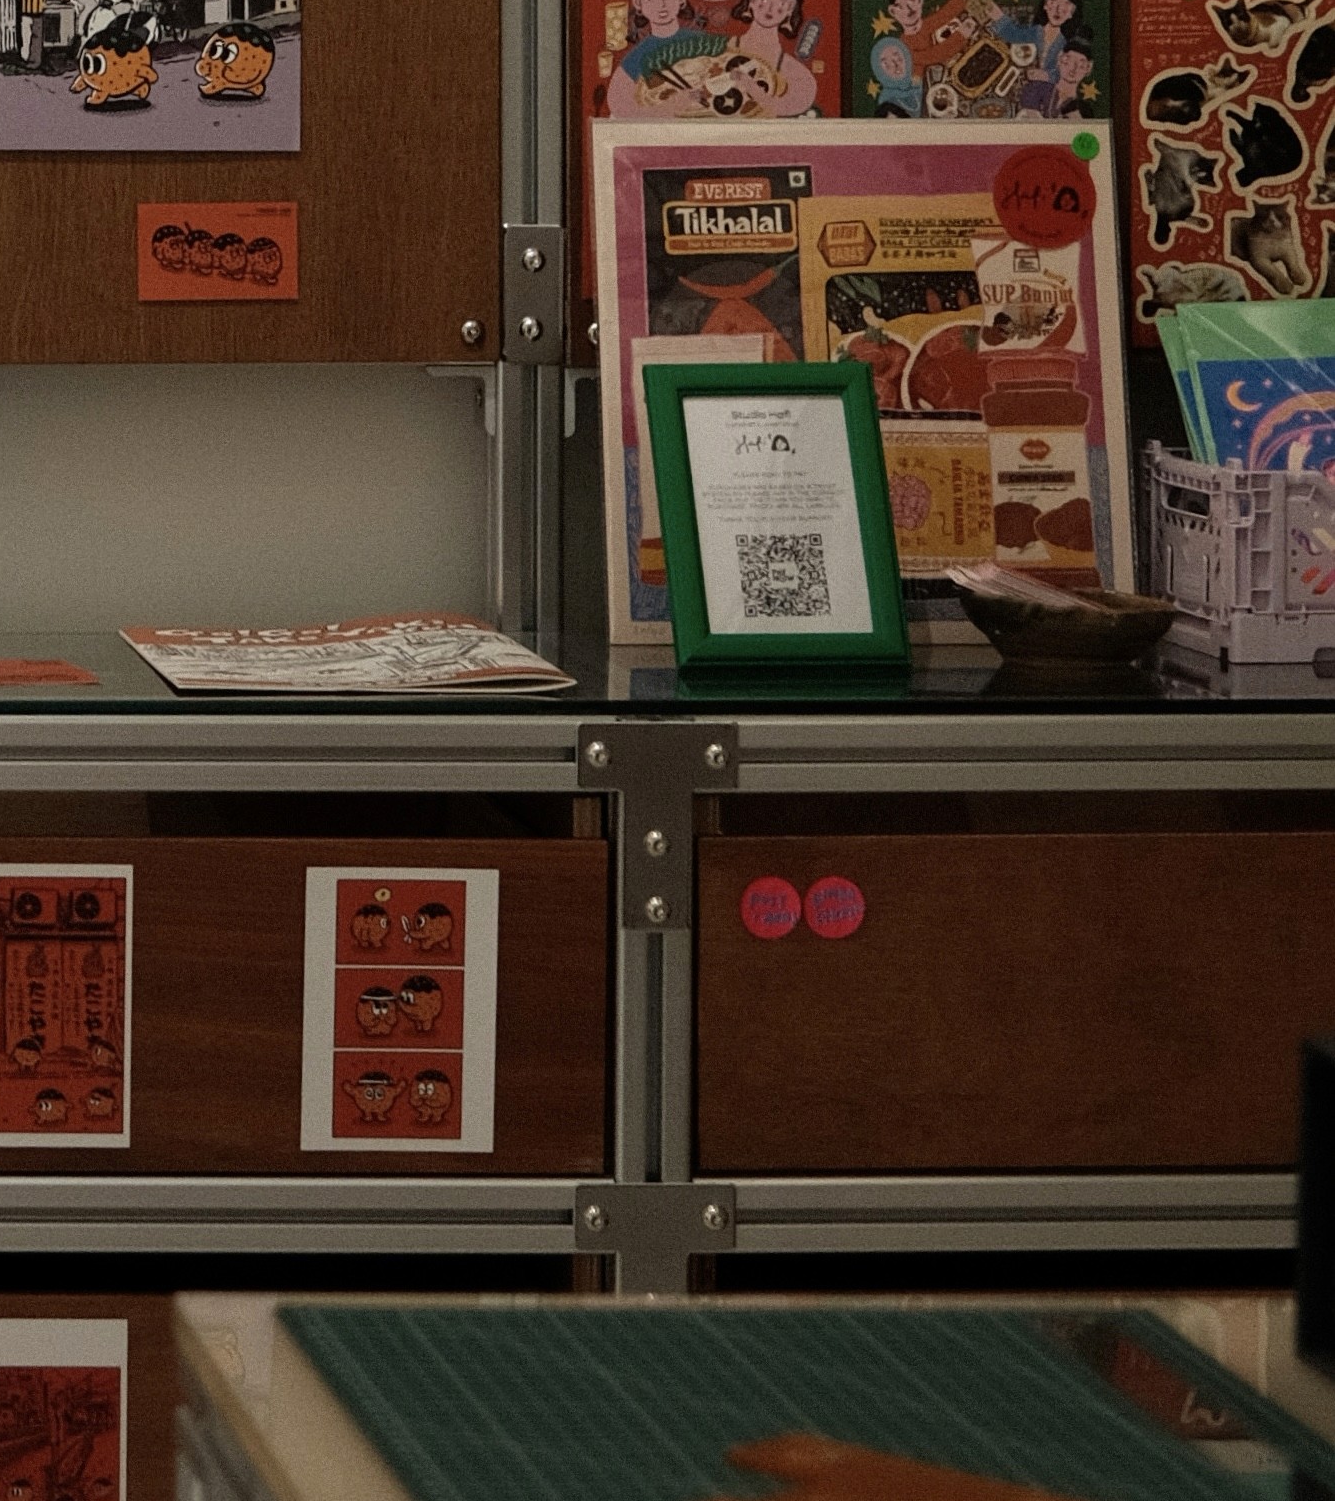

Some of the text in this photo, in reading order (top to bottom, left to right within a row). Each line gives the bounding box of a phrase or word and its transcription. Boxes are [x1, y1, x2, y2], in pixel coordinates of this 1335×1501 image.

[693, 182, 763, 200] EVEREST
[674, 207, 784, 235] Tikhalal
[982, 284, 1015, 304] SUP
